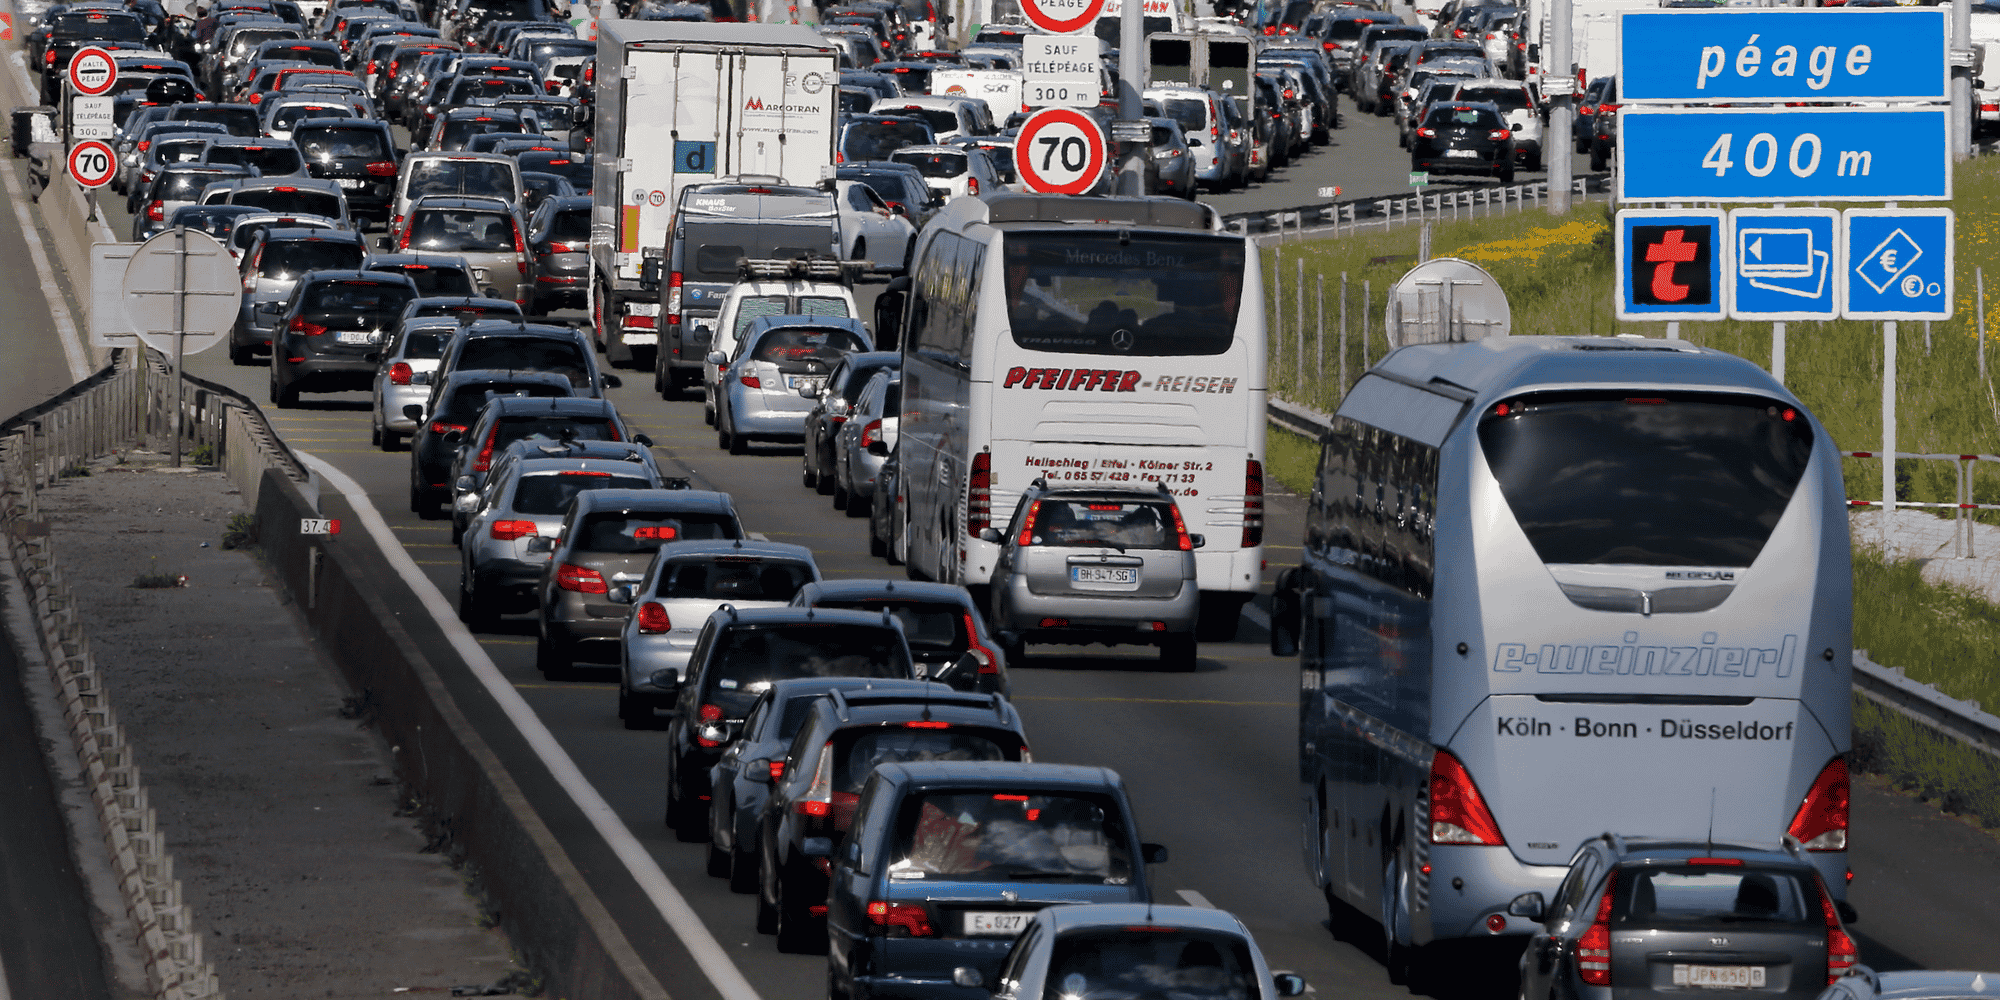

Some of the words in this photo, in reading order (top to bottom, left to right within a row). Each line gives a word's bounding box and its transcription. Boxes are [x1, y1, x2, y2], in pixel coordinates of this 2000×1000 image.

[1044, 45, 1078, 55] SAUF
[1027, 61, 1095, 73] TÉLÉPÉAGE
[1697, 34, 1872, 90] péage
[1035, 88, 1068, 101] 300
[1076, 92, 1088, 101] m
[80, 128, 97, 136] 300
[686, 145, 705, 170] d
[1038, 136, 1086, 172] 70
[1702, 133, 1822, 178] 400
[1837, 150, 1872, 176] m
[80, 154, 107, 172] 70
[652, 194, 662, 203] 70
[695, 199, 726, 207] KNAUS
[1065, 249, 1140, 266] Mercedes
[1146, 251, 1185, 268] Benz
[1021, 337, 1097, 345] TRAVEGO
[1025, 456, 1089, 470] Hallschlag
[1101, 459, 1128, 469] Eifel
[1139, 459, 1179, 470] Kölner
[1041, 469, 1062, 480] Tel.
[1141, 472, 1161, 482] Fax
[1498, 717, 1552, 737] Köln
[1574, 718, 1638, 738] Bonn
[1660, 719, 1794, 741] Düsseldorf
